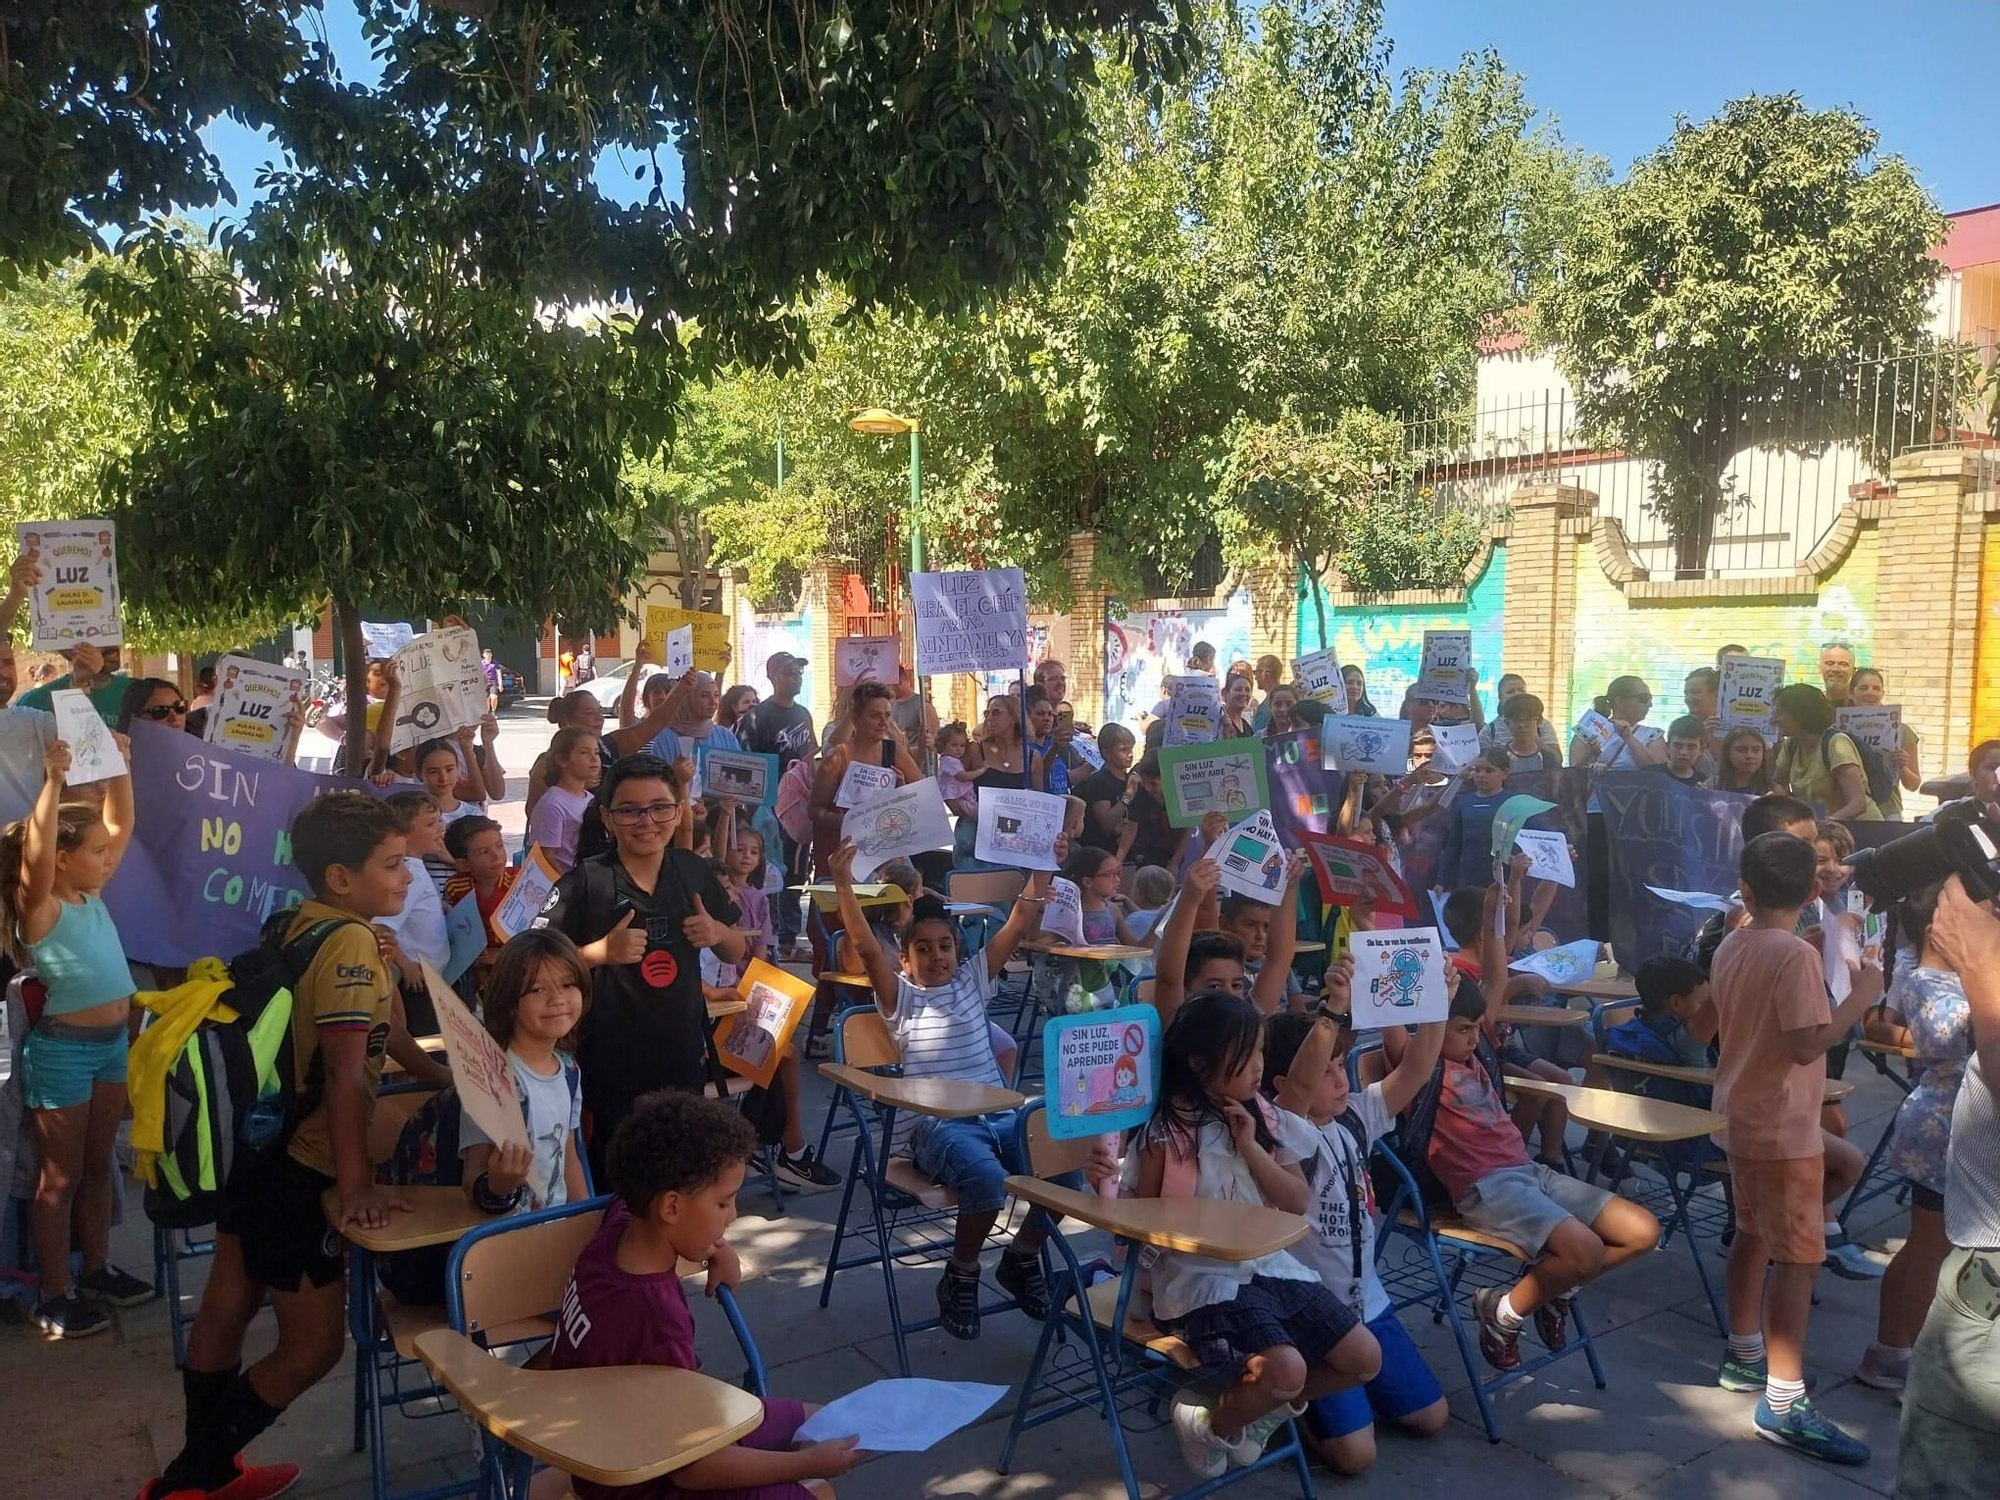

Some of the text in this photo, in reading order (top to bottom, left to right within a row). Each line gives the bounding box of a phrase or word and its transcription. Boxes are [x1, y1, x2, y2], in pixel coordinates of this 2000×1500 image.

[53, 545, 92, 557] QUEREMOS
[55, 567, 89, 584] LUZ
[940, 575, 979, 596] LUZ
[956, 597, 977, 616] EL
[1437, 657, 1458, 667] LUZ
[1311, 676, 1329, 689] LUZ
[244, 683, 281, 699] QUEREMOS
[1738, 686, 1763, 698] LUZ
[239, 701, 272, 719] LUZ
[1186, 704, 1208, 715] LUZ
[1863, 735, 1880, 745] UZ
[1185, 761, 1214, 772] SIN LUZ
[176, 754, 259, 807] SIN
[1180, 768, 1226, 781] NO HAY AIRE
[201, 816, 242, 855] NO
[1257, 829, 1271, 840] HAY
[337, 964, 375, 981] beko
[1072, 1027, 1110, 1040] SIN LUZ,
[1063, 1039, 1119, 1055] NO SE PUEDE
[1067, 1054, 1114, 1068] APRENDER
[1319, 1201, 1345, 1213] THE
